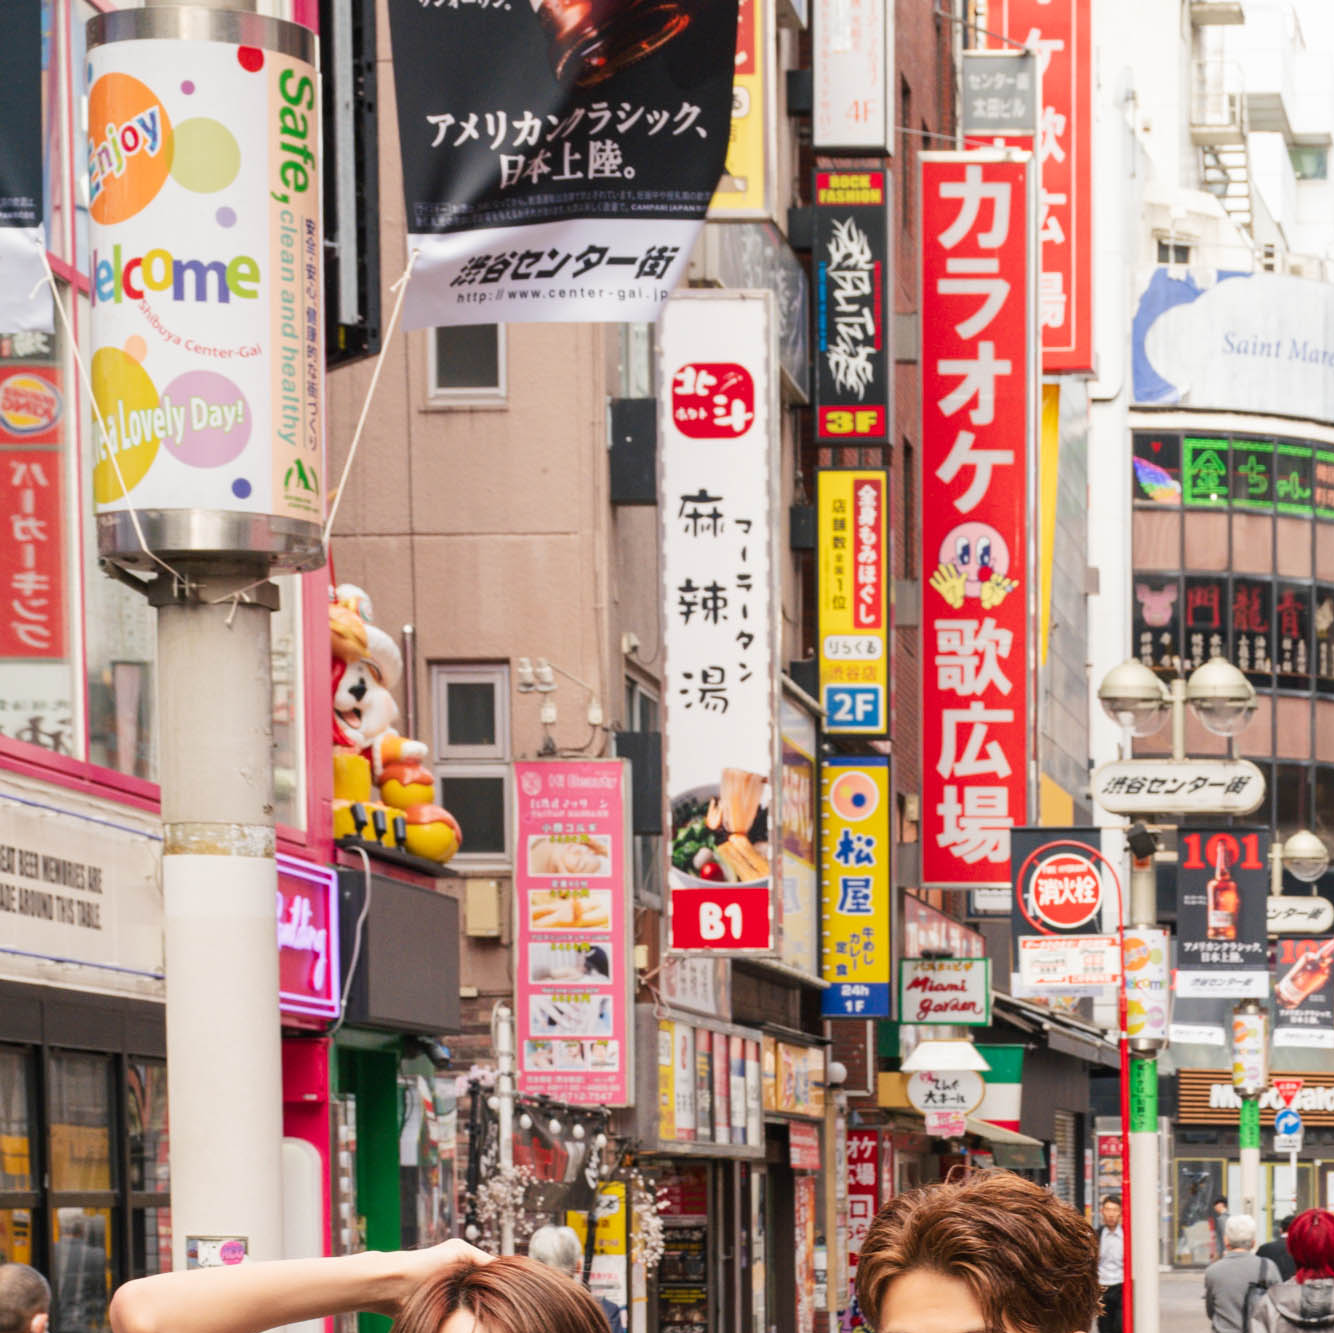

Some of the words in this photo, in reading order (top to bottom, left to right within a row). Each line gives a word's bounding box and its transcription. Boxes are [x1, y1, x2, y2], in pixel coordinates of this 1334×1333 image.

[271, 68, 315, 204] Safe,
[426, 101, 708, 149] アメリカンクラシック、
[500, 140, 636, 189] 日本上陸。
[279, 209, 297, 283] clean
[450, 244, 681, 287] 渋谷センター街
[138, 299, 182, 345] Shibuya
[281, 289, 299, 339] and
[937, 165, 1014, 513] カラオケ
[1221, 331, 1282, 360] Saint
[278, 346, 300, 446] healthy
[118, 396, 185, 450] Lovely
[190, 398, 244, 433] Day!
[825, 410, 877, 434] 3F
[10, 460, 51, 649] バーガーキング
[677, 489, 729, 714] 麻辣湯
[735, 519, 754, 683] マーラータン
[833, 693, 875, 721] 2F
[935, 617, 1014, 865] 歌広場
[1101, 775, 1252, 796] 渋谷センター街
[834, 830, 875, 914] 松屋
[1183, 833, 1263, 869] 101
[1037, 878, 1097, 906] 消火栓
[1268, 906, 1325, 921] ンター街
[699, 901, 743, 941] B1
[850, 933, 862, 970] カレー
[841, 985, 870, 997] 24h
[845, 1001, 865, 1013] 1F
[906, 977, 967, 992] Miami
